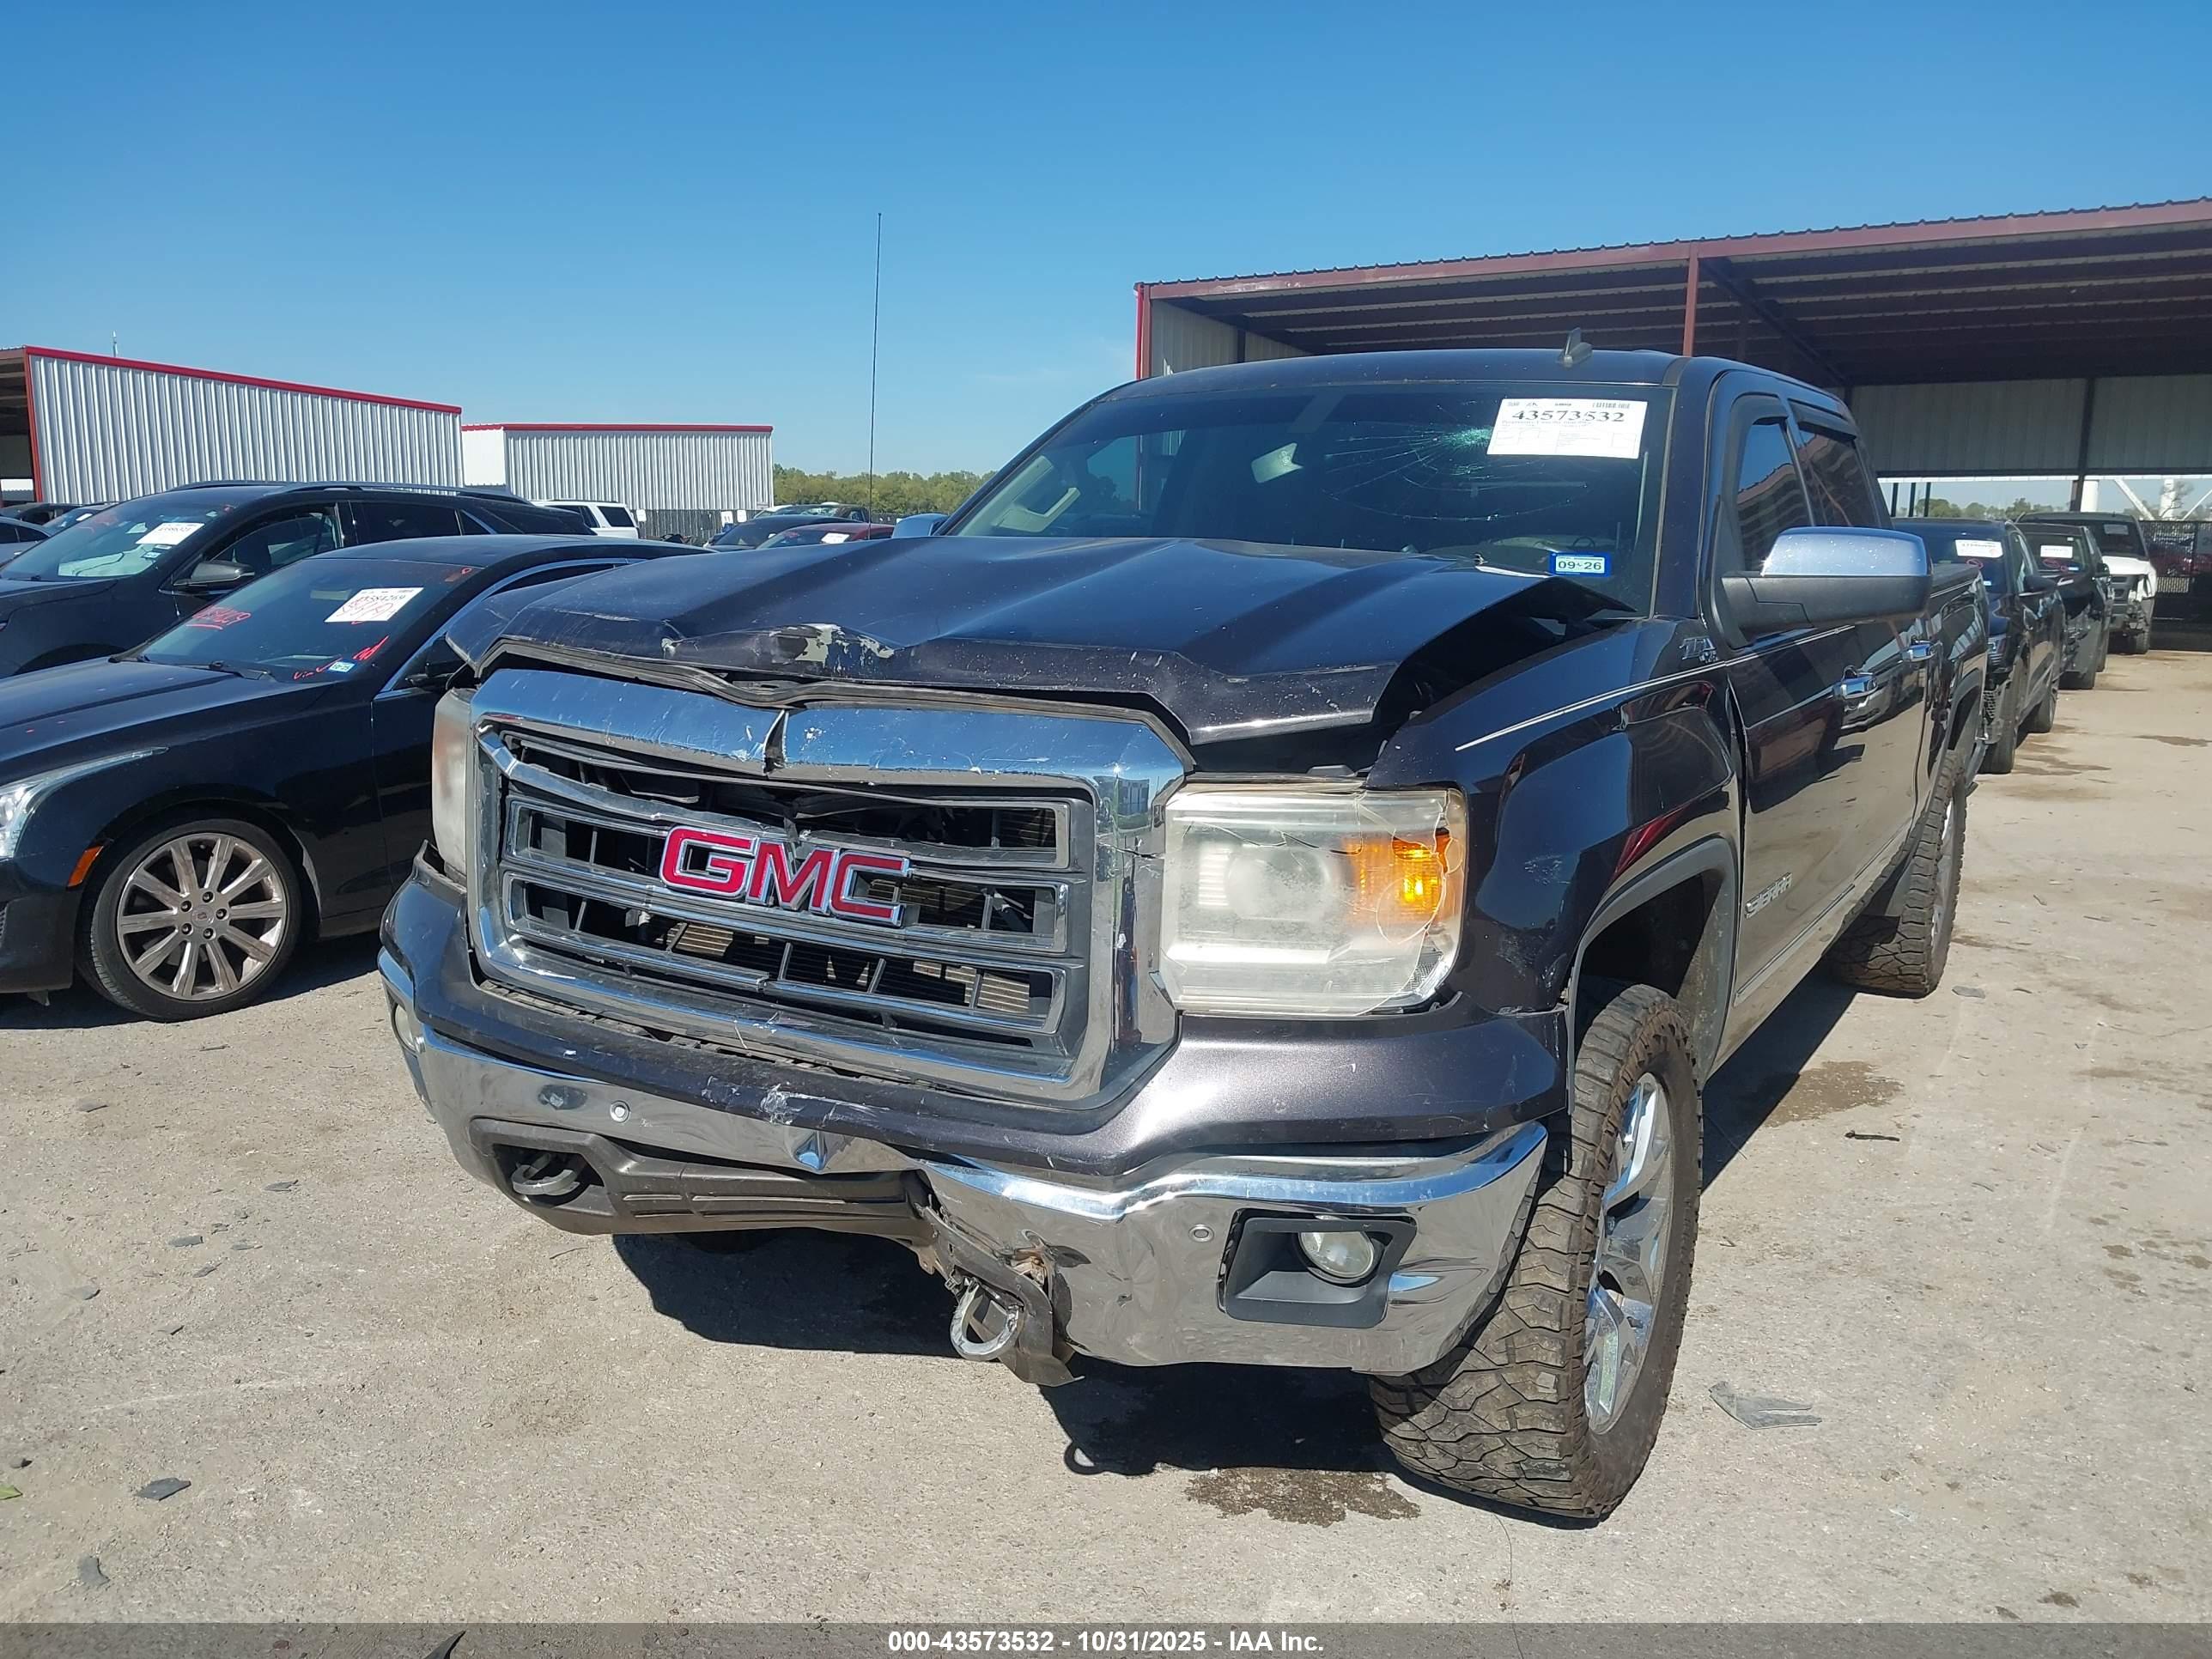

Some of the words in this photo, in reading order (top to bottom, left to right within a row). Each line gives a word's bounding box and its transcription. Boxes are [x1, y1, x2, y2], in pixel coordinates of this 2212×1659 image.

[1512, 410, 1625, 422] 43573532
[1558, 561, 1576, 569] 09
[1583, 562, 1602, 570] 26
[659, 825, 908, 927] GMC
